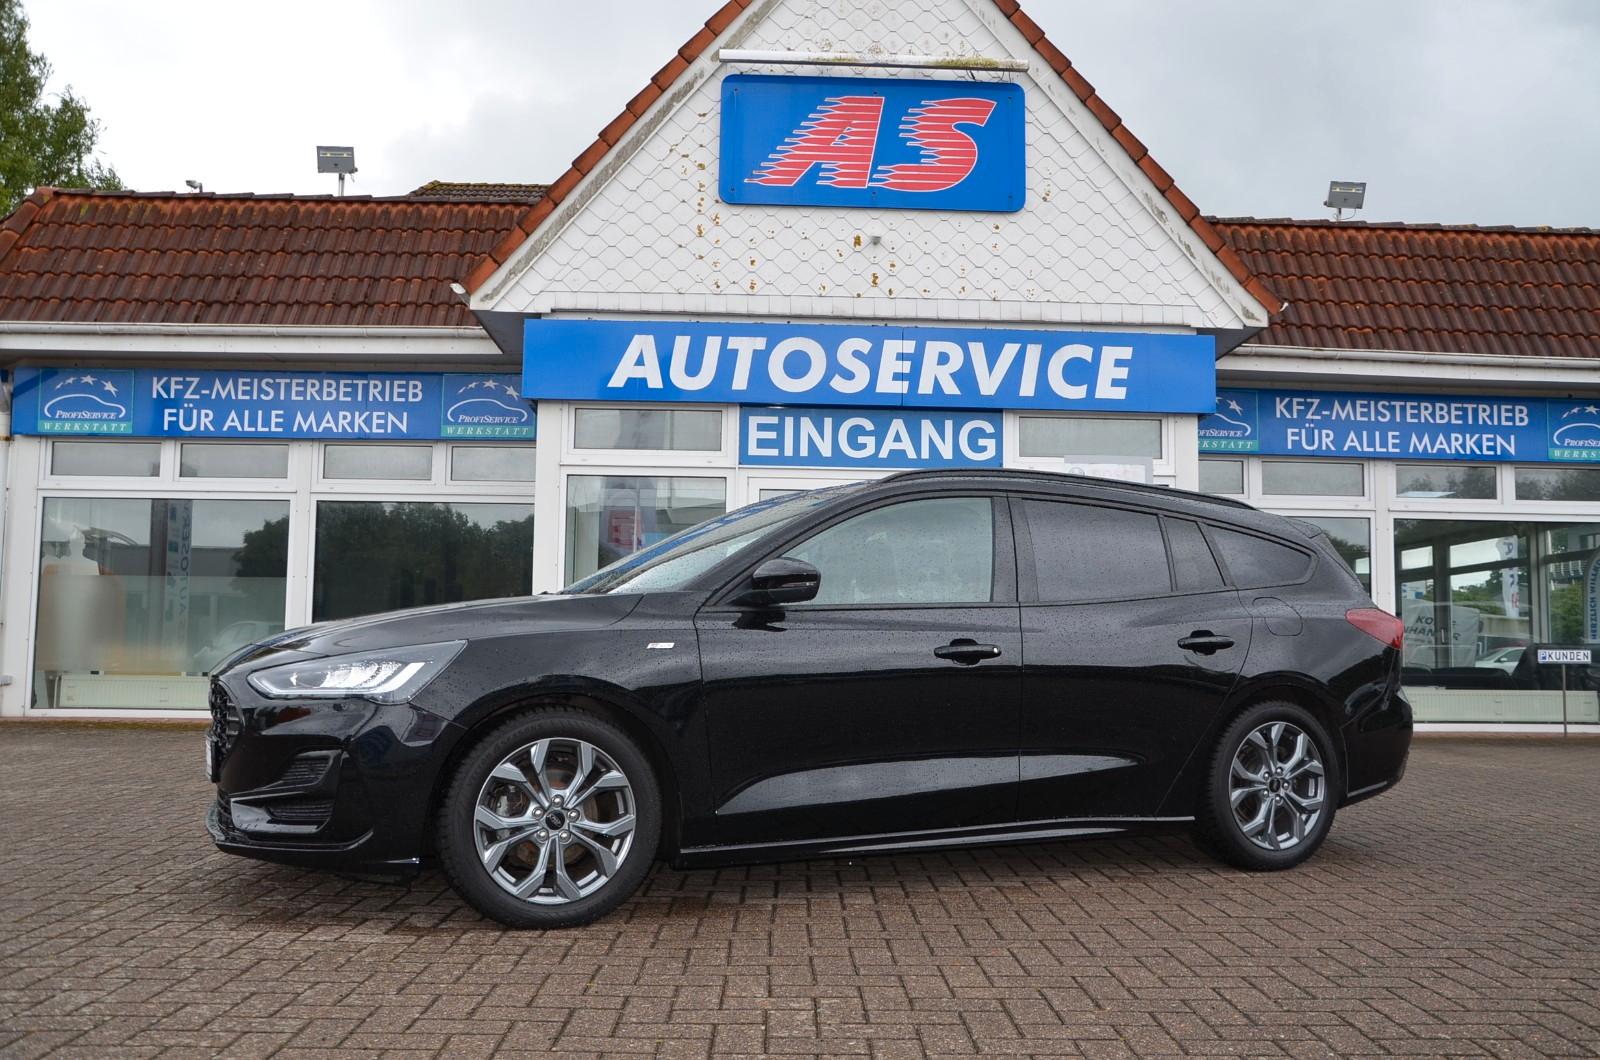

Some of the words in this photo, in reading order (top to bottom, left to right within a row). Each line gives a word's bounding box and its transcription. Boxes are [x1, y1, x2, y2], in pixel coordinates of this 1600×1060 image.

[744, 95, 997, 192] AS
[606, 334, 1134, 400] AUTOSERVICE
[151, 376, 423, 402] KFZ-MEISTERBETRIEB
[43, 421, 127, 432] WERKSTATT
[163, 403, 215, 432] FÜR
[222, 409, 284, 432] ALLE
[292, 410, 408, 434] MARKEN
[1275, 397, 1529, 427] KFZ-MEISTERBETRIEB
[447, 426, 529, 435] WERKSTATT
[746, 415, 997, 461] EINGANG
[1287, 423, 1336, 451] FÜR
[1343, 430, 1400, 453] ALLE
[1408, 432, 1516, 457] MARKEN
[1548, 651, 1589, 661] KUNDEN
